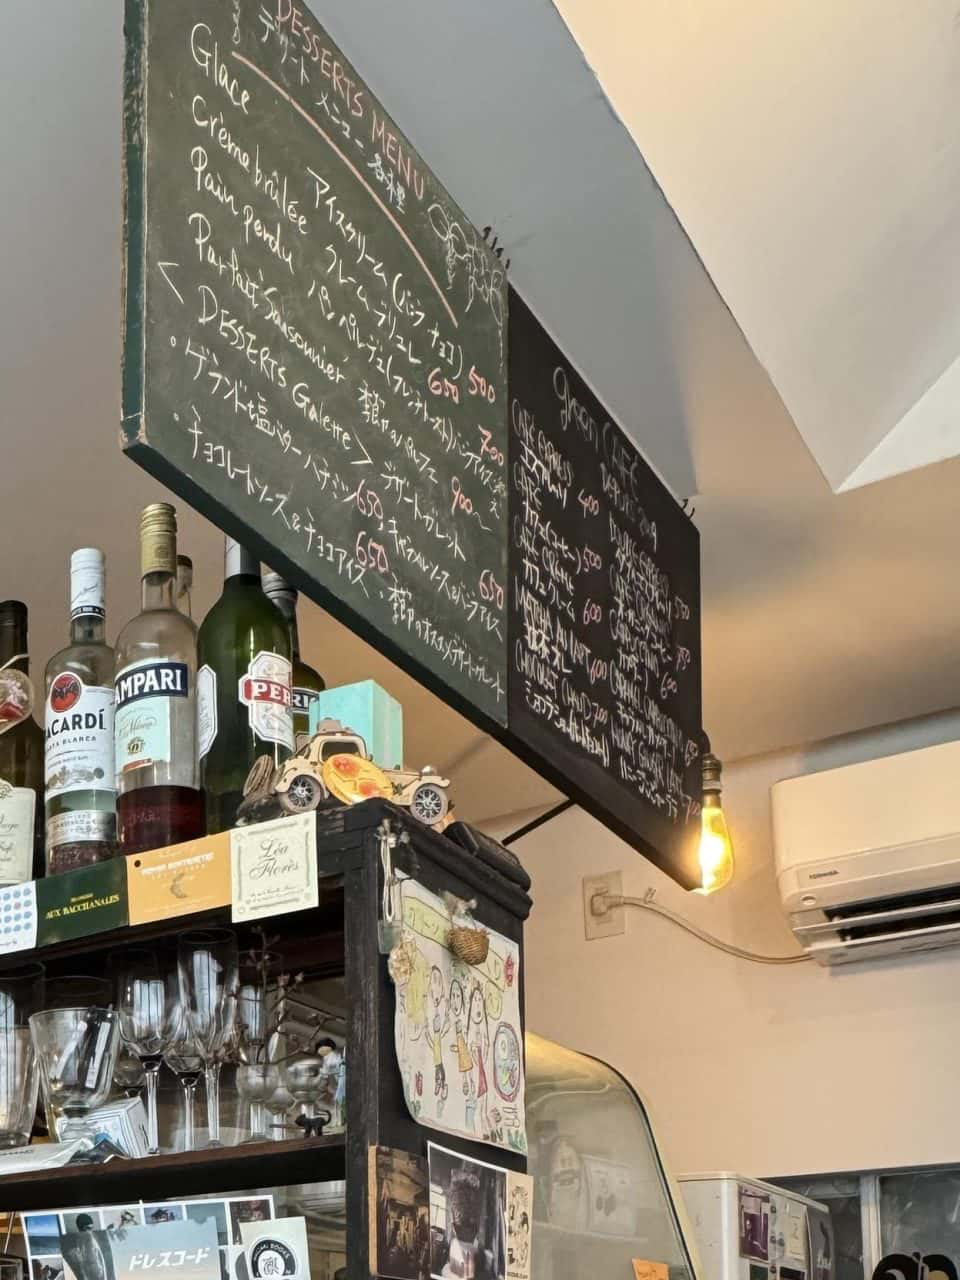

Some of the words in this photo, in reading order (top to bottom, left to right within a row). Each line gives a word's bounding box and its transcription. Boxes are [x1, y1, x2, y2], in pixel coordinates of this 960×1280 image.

[371, 112, 424, 199] MENU
[190, 22, 249, 113] Glace
[468, 365, 495, 403] 500
[198, 285, 286, 387] DESSERTS
[478, 425, 504, 466] 700
[355, 530, 389, 589] 650
[478, 569, 504, 609] 650
[128, 1248, 210, 1272] ドレスコード
